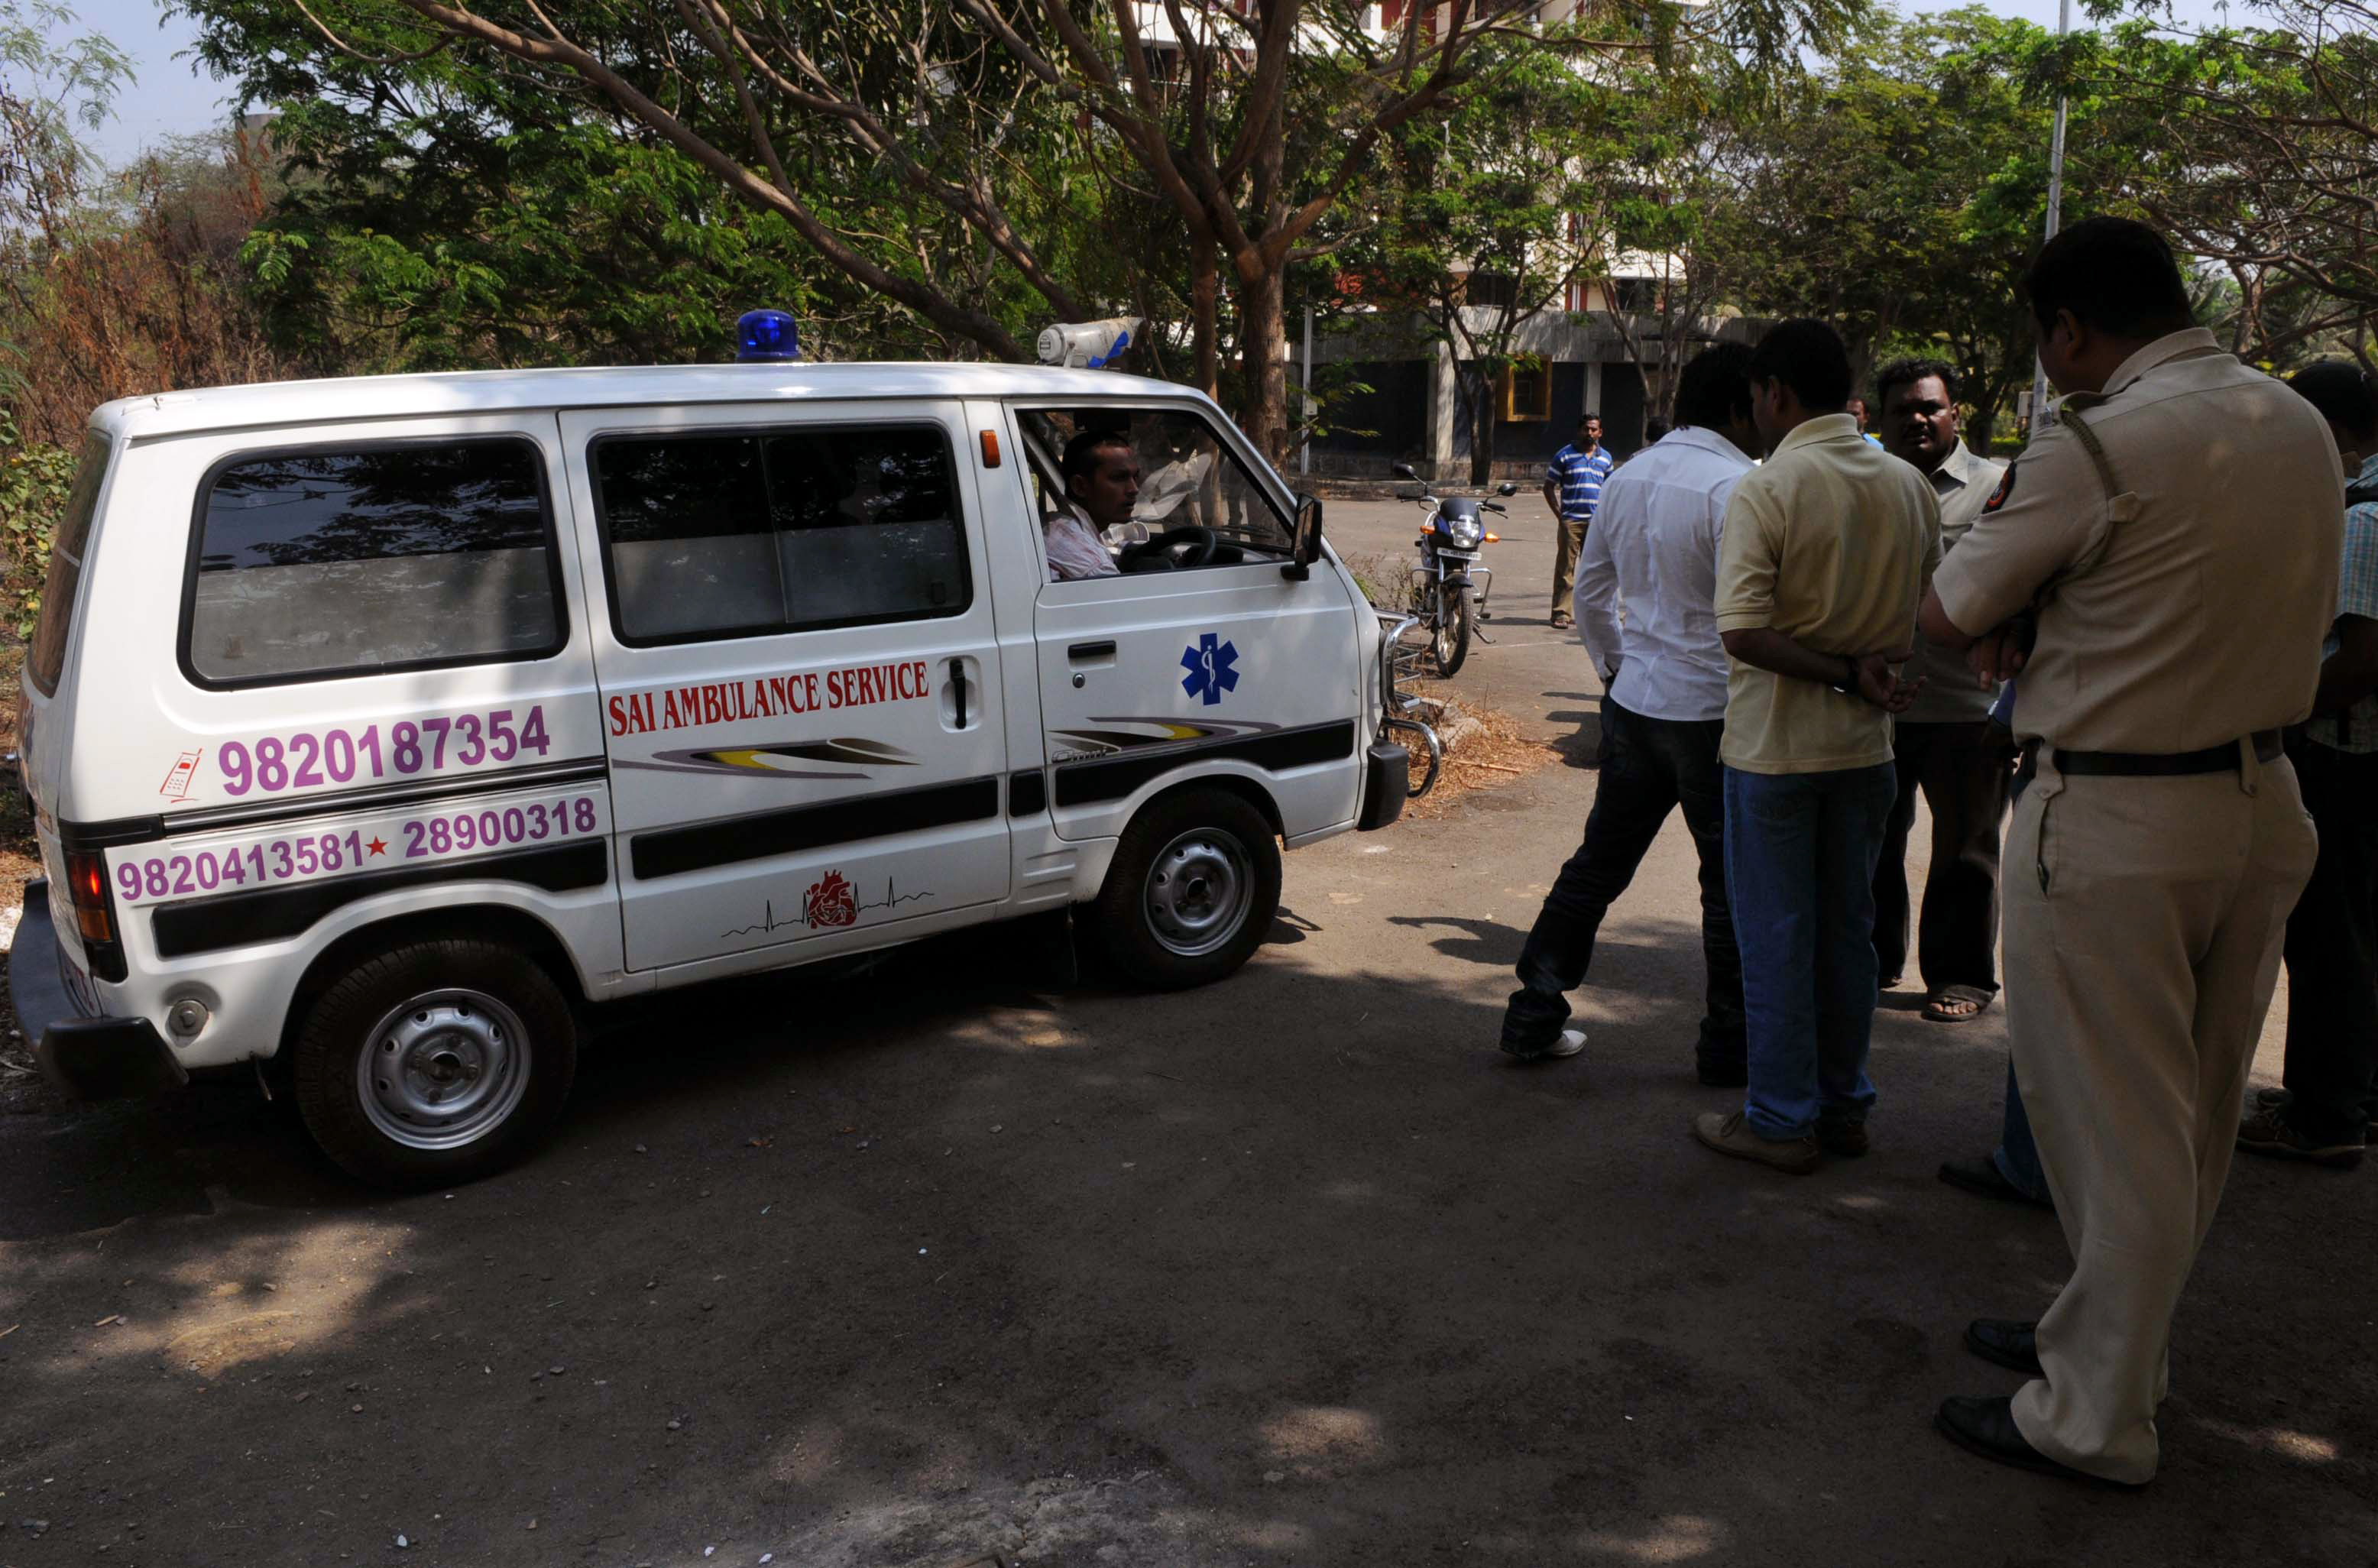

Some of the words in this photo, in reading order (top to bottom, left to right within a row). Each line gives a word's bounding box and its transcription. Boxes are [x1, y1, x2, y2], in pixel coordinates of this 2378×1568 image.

[608, 692, 656, 737] SAI
[663, 672, 821, 730] AMBULANCE
[827, 661, 929, 709] SERVICE
[218, 705, 549, 796] 9820187354
[117, 830, 363, 902] 9820413581
[402, 797, 597, 858] 28900318
